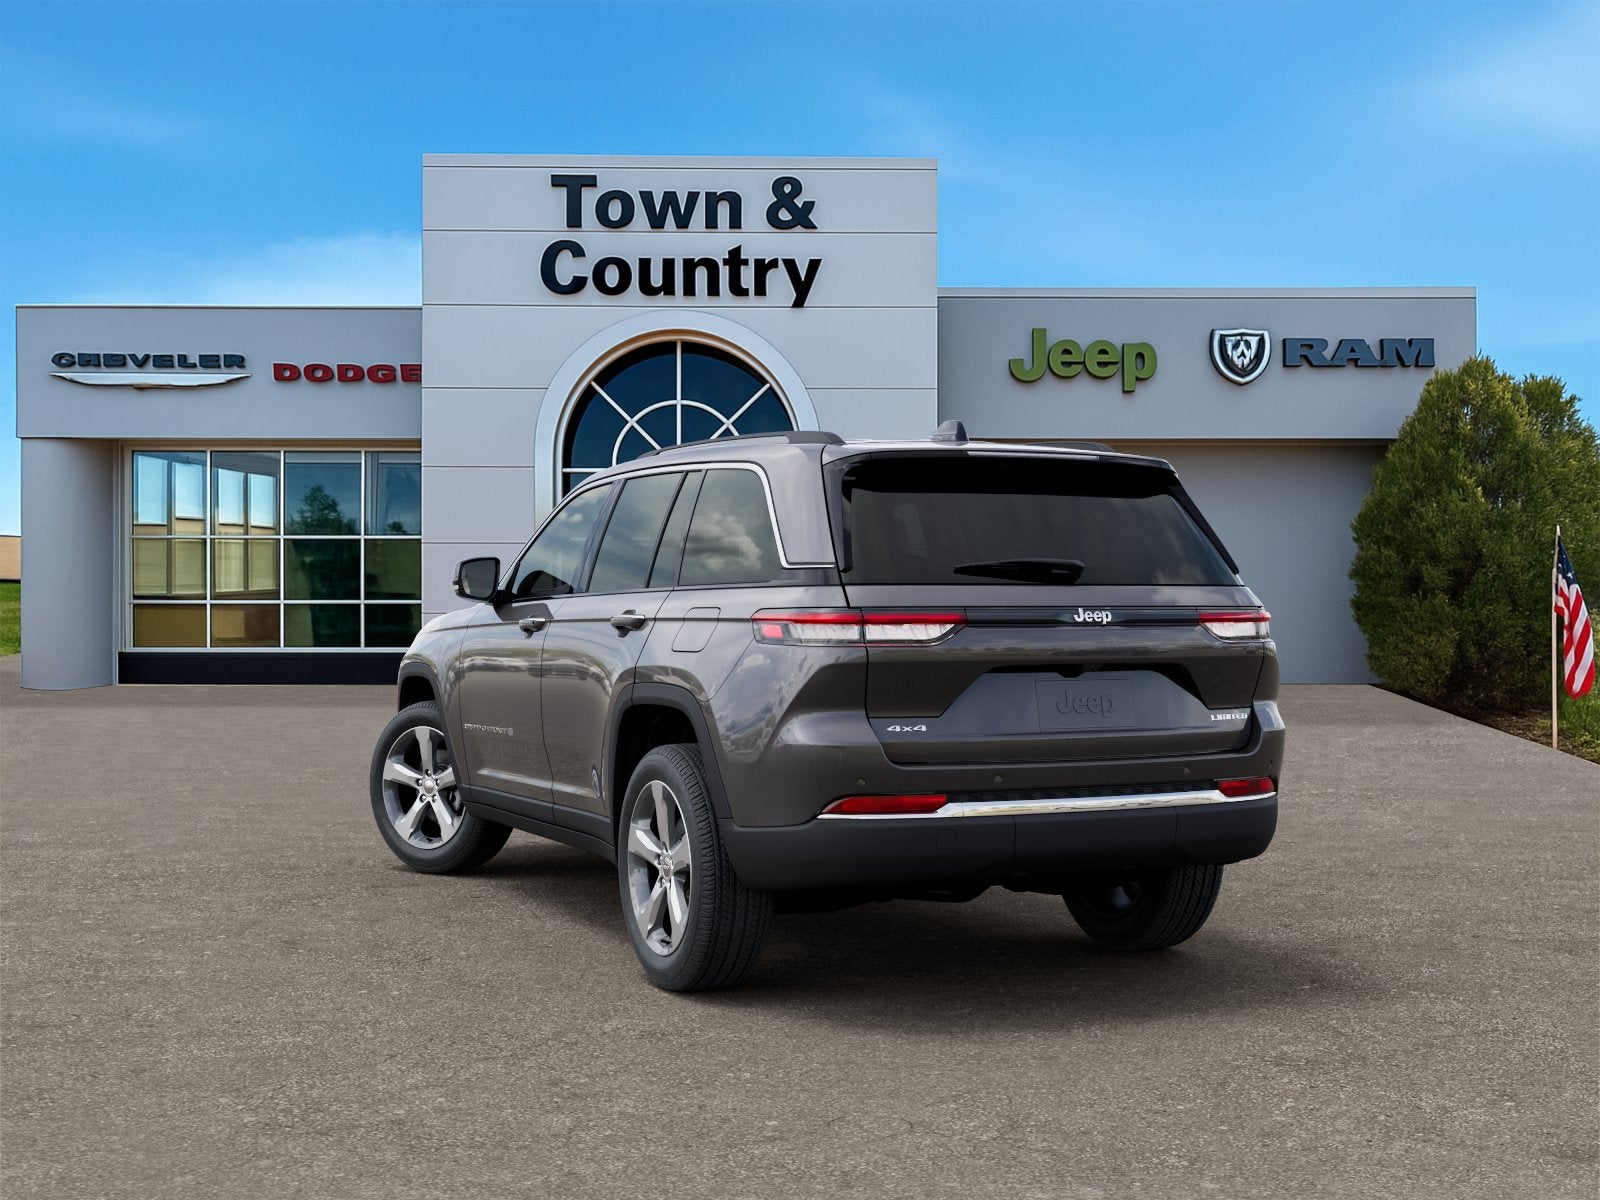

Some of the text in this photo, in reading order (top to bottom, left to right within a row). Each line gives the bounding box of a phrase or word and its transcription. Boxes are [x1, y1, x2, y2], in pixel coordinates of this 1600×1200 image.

[550, 174, 818, 230] Town &
[540, 239, 823, 308] Country
[1009, 328, 1158, 393] Jeep
[1283, 338, 1435, 367] RAM
[273, 363, 422, 383] DODGE
[1073, 607, 1112, 625] Jeep
[1056, 688, 1117, 718] Jeep
[886, 724, 927, 732] 4x4
